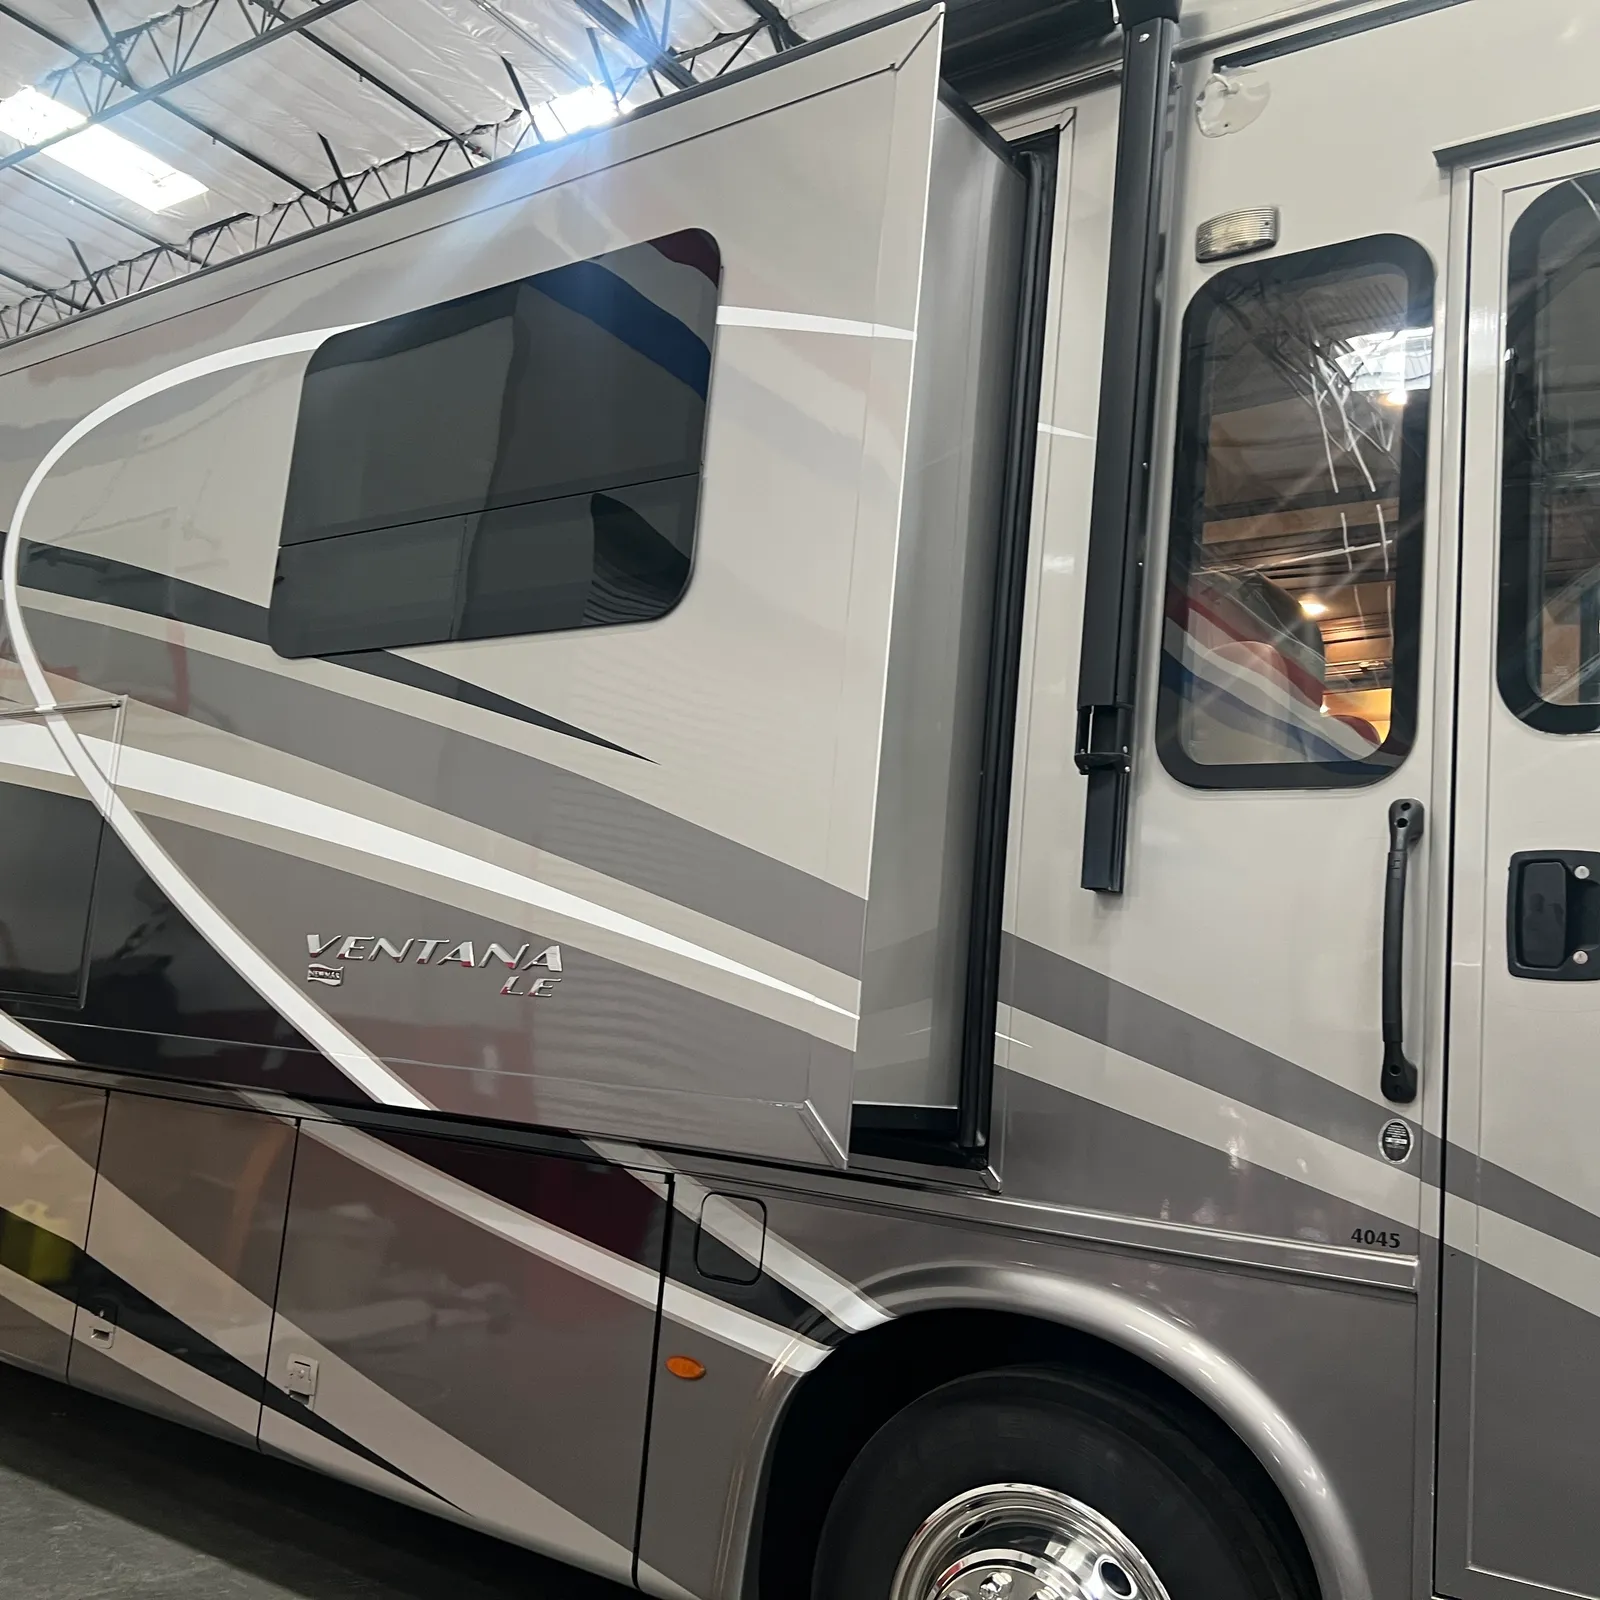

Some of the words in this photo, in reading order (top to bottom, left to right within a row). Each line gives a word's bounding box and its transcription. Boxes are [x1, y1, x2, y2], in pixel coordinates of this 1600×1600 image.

[306, 934, 563, 972] VENTANA
[500, 975, 562, 997] LE
[1351, 1228, 1400, 1249] 4045
